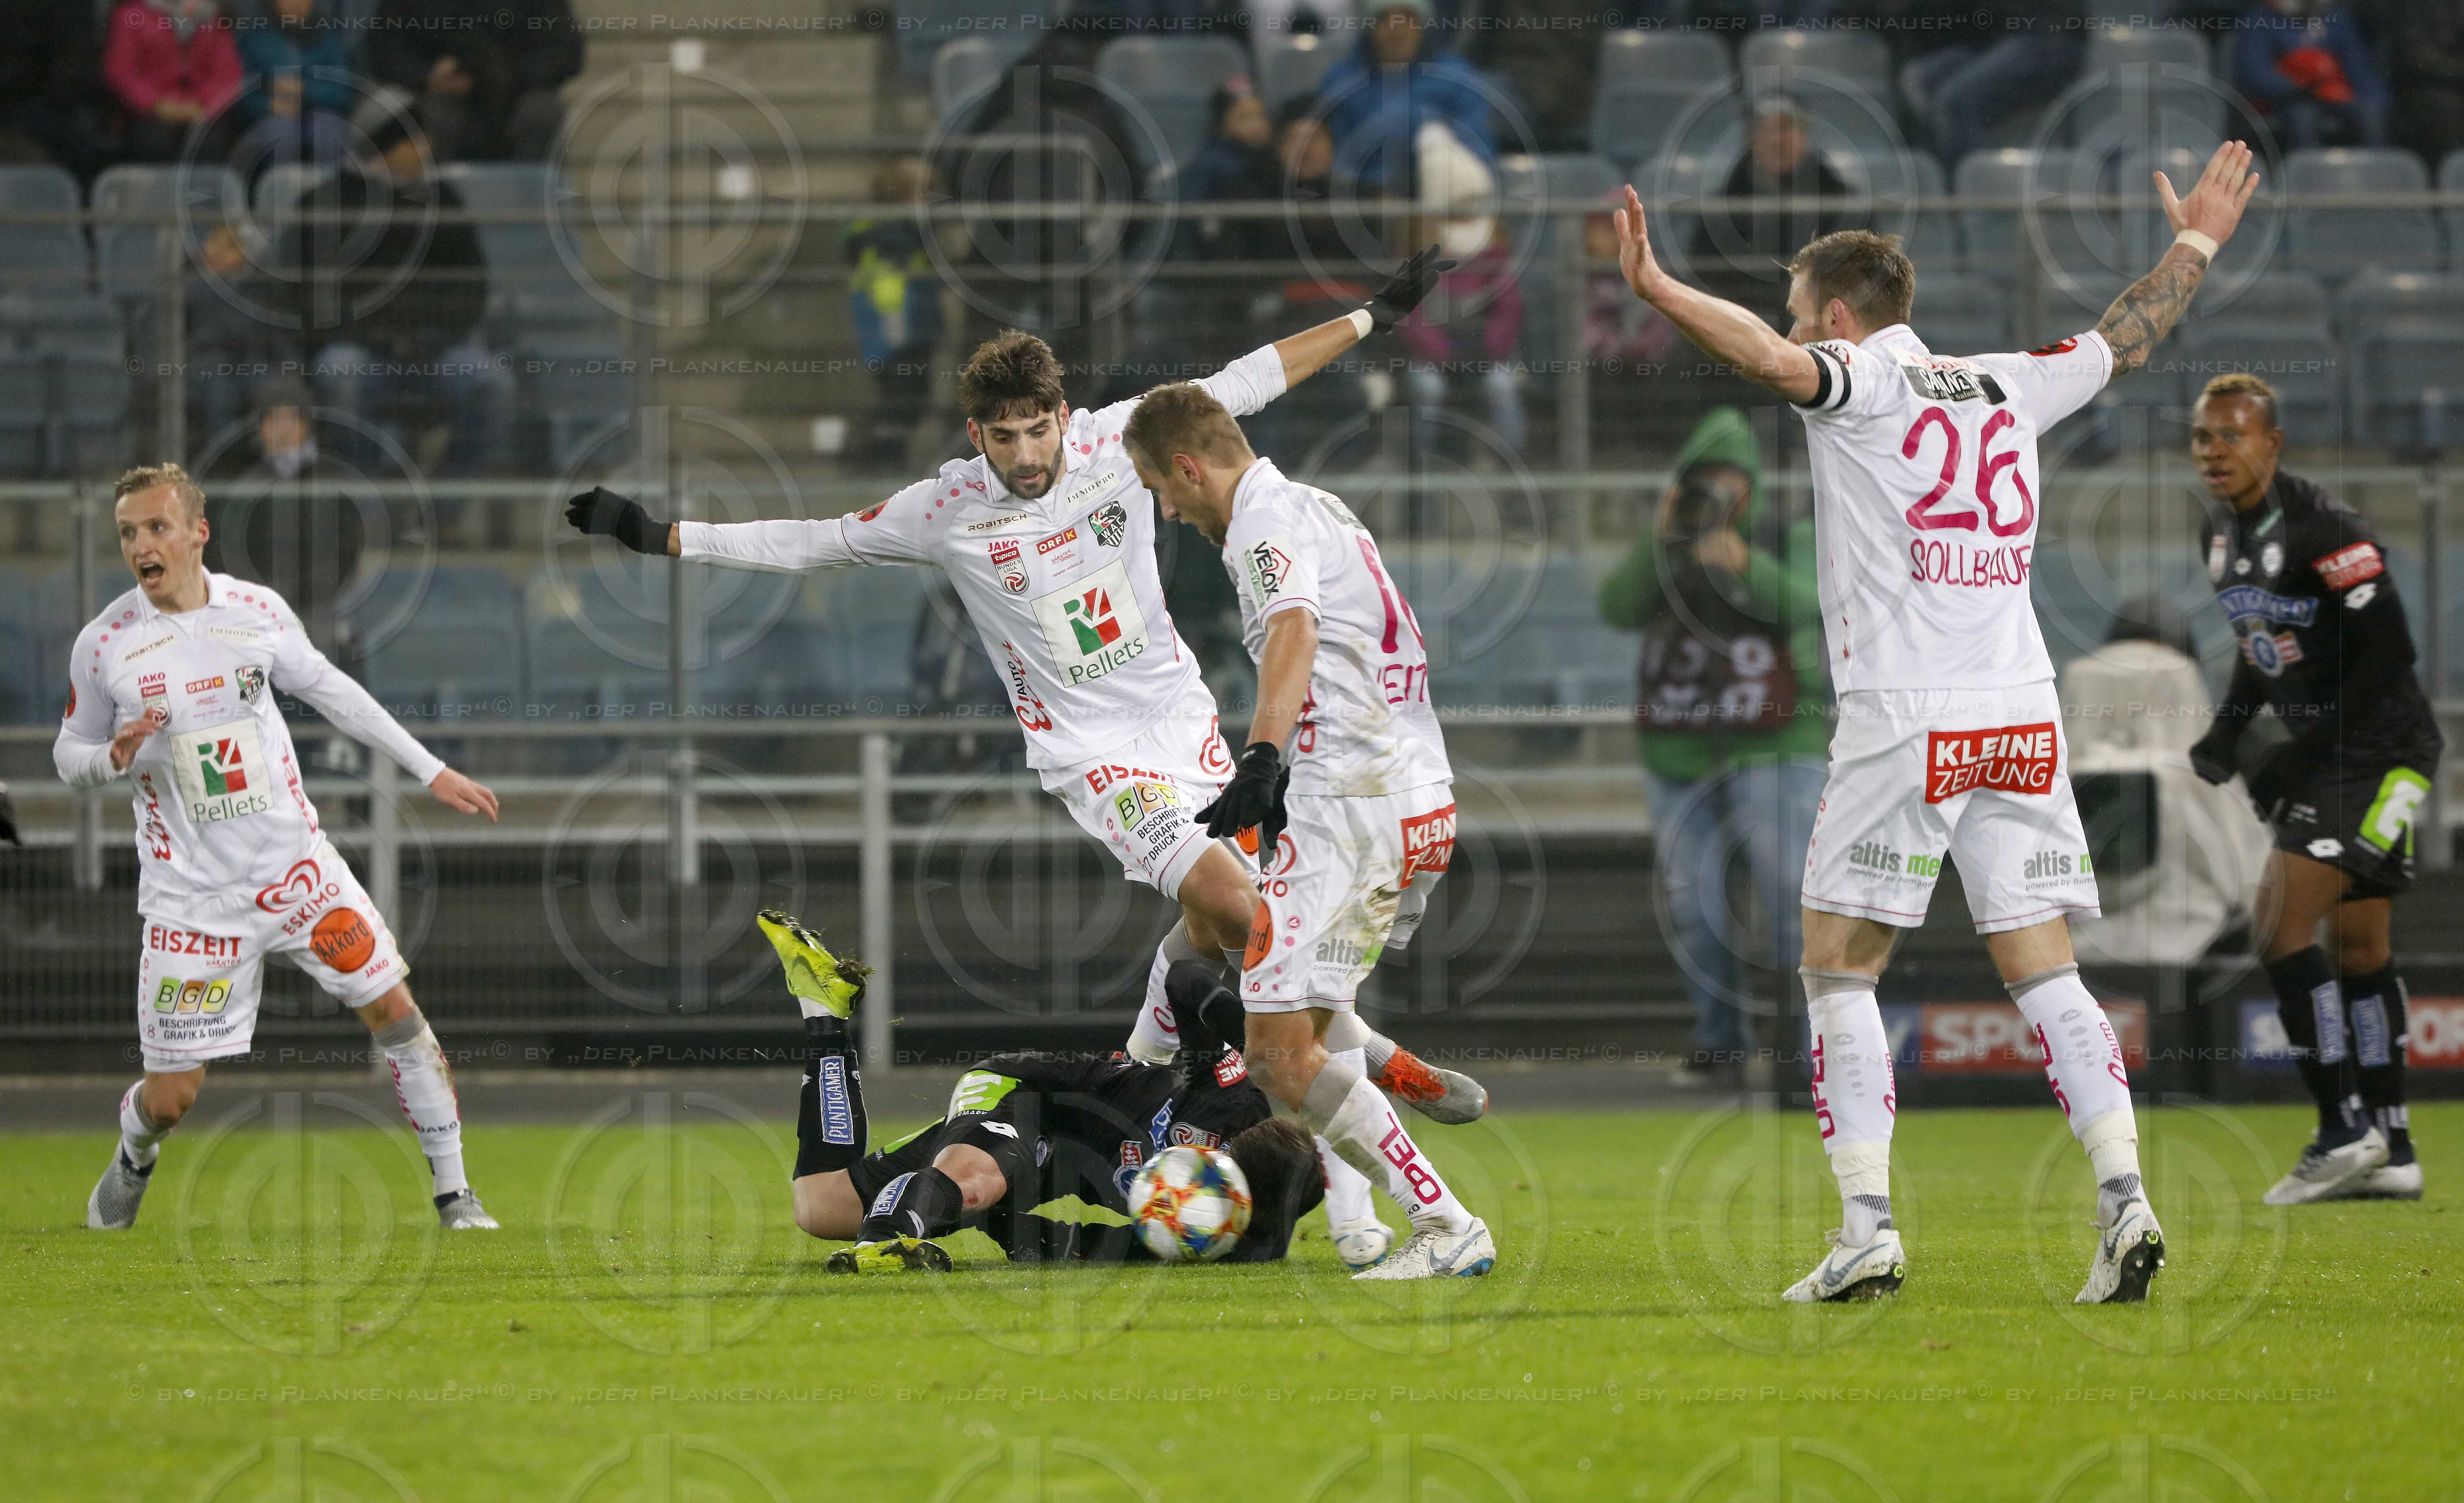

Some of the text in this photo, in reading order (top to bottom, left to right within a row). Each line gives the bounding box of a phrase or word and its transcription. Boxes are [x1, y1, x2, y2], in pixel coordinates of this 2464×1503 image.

[1902, 406, 2034, 537] 26
[1067, 473, 1114, 503] IMMOPRO
[1081, 487, 1107, 503] SOLUTION
[968, 514, 1026, 531] ROBITSCH
[1101, 517, 1123, 539] WAC
[988, 540, 1019, 552] JAKO
[1039, 530, 1075, 552] ORF K
[994, 550, 1017, 561] tipico
[997, 559, 1021, 570] BUNDES
[1253, 541, 1279, 600] VELOX
[125, 635, 174, 661] ROBITSCH
[1069, 637, 1143, 684] Pellets
[138, 672, 166, 685] JAKO
[188, 678, 223, 692] ORF K
[1008, 661, 1027, 695] AUTO
[1936, 731, 2052, 767] KLEINE
[1934, 761, 2050, 797] ZEITUNG
[194, 794, 267, 822] Pellets
[1137, 806, 1191, 839] BESCHRIFTUNG
[1149, 819, 1181, 844] GRAFIK
[1149, 833, 1179, 860] DRUCK
[1850, 841, 1901, 872] altis
[1847, 866, 1882, 880] powered
[2024, 850, 2071, 879] altis
[2026, 879, 2058, 891] powered
[282, 882, 340, 936] ESKIMO
[151, 926, 242, 958] EISZEIT
[315, 913, 370, 962] Akkord
[1316, 938, 1363, 966] altis
[365, 959, 389, 979] JAKO
[1313, 965, 1347, 974] powered
[159, 985, 224, 1003] BGD
[148, 1025, 155, 1038] 8
[159, 1016, 226, 1028] BESCHRIFTUNG
[164, 1030, 197, 1040] GRAFIK
[200, 1028, 205, 1038] &
[825, 1061, 848, 1138] PUNTIGAMER
